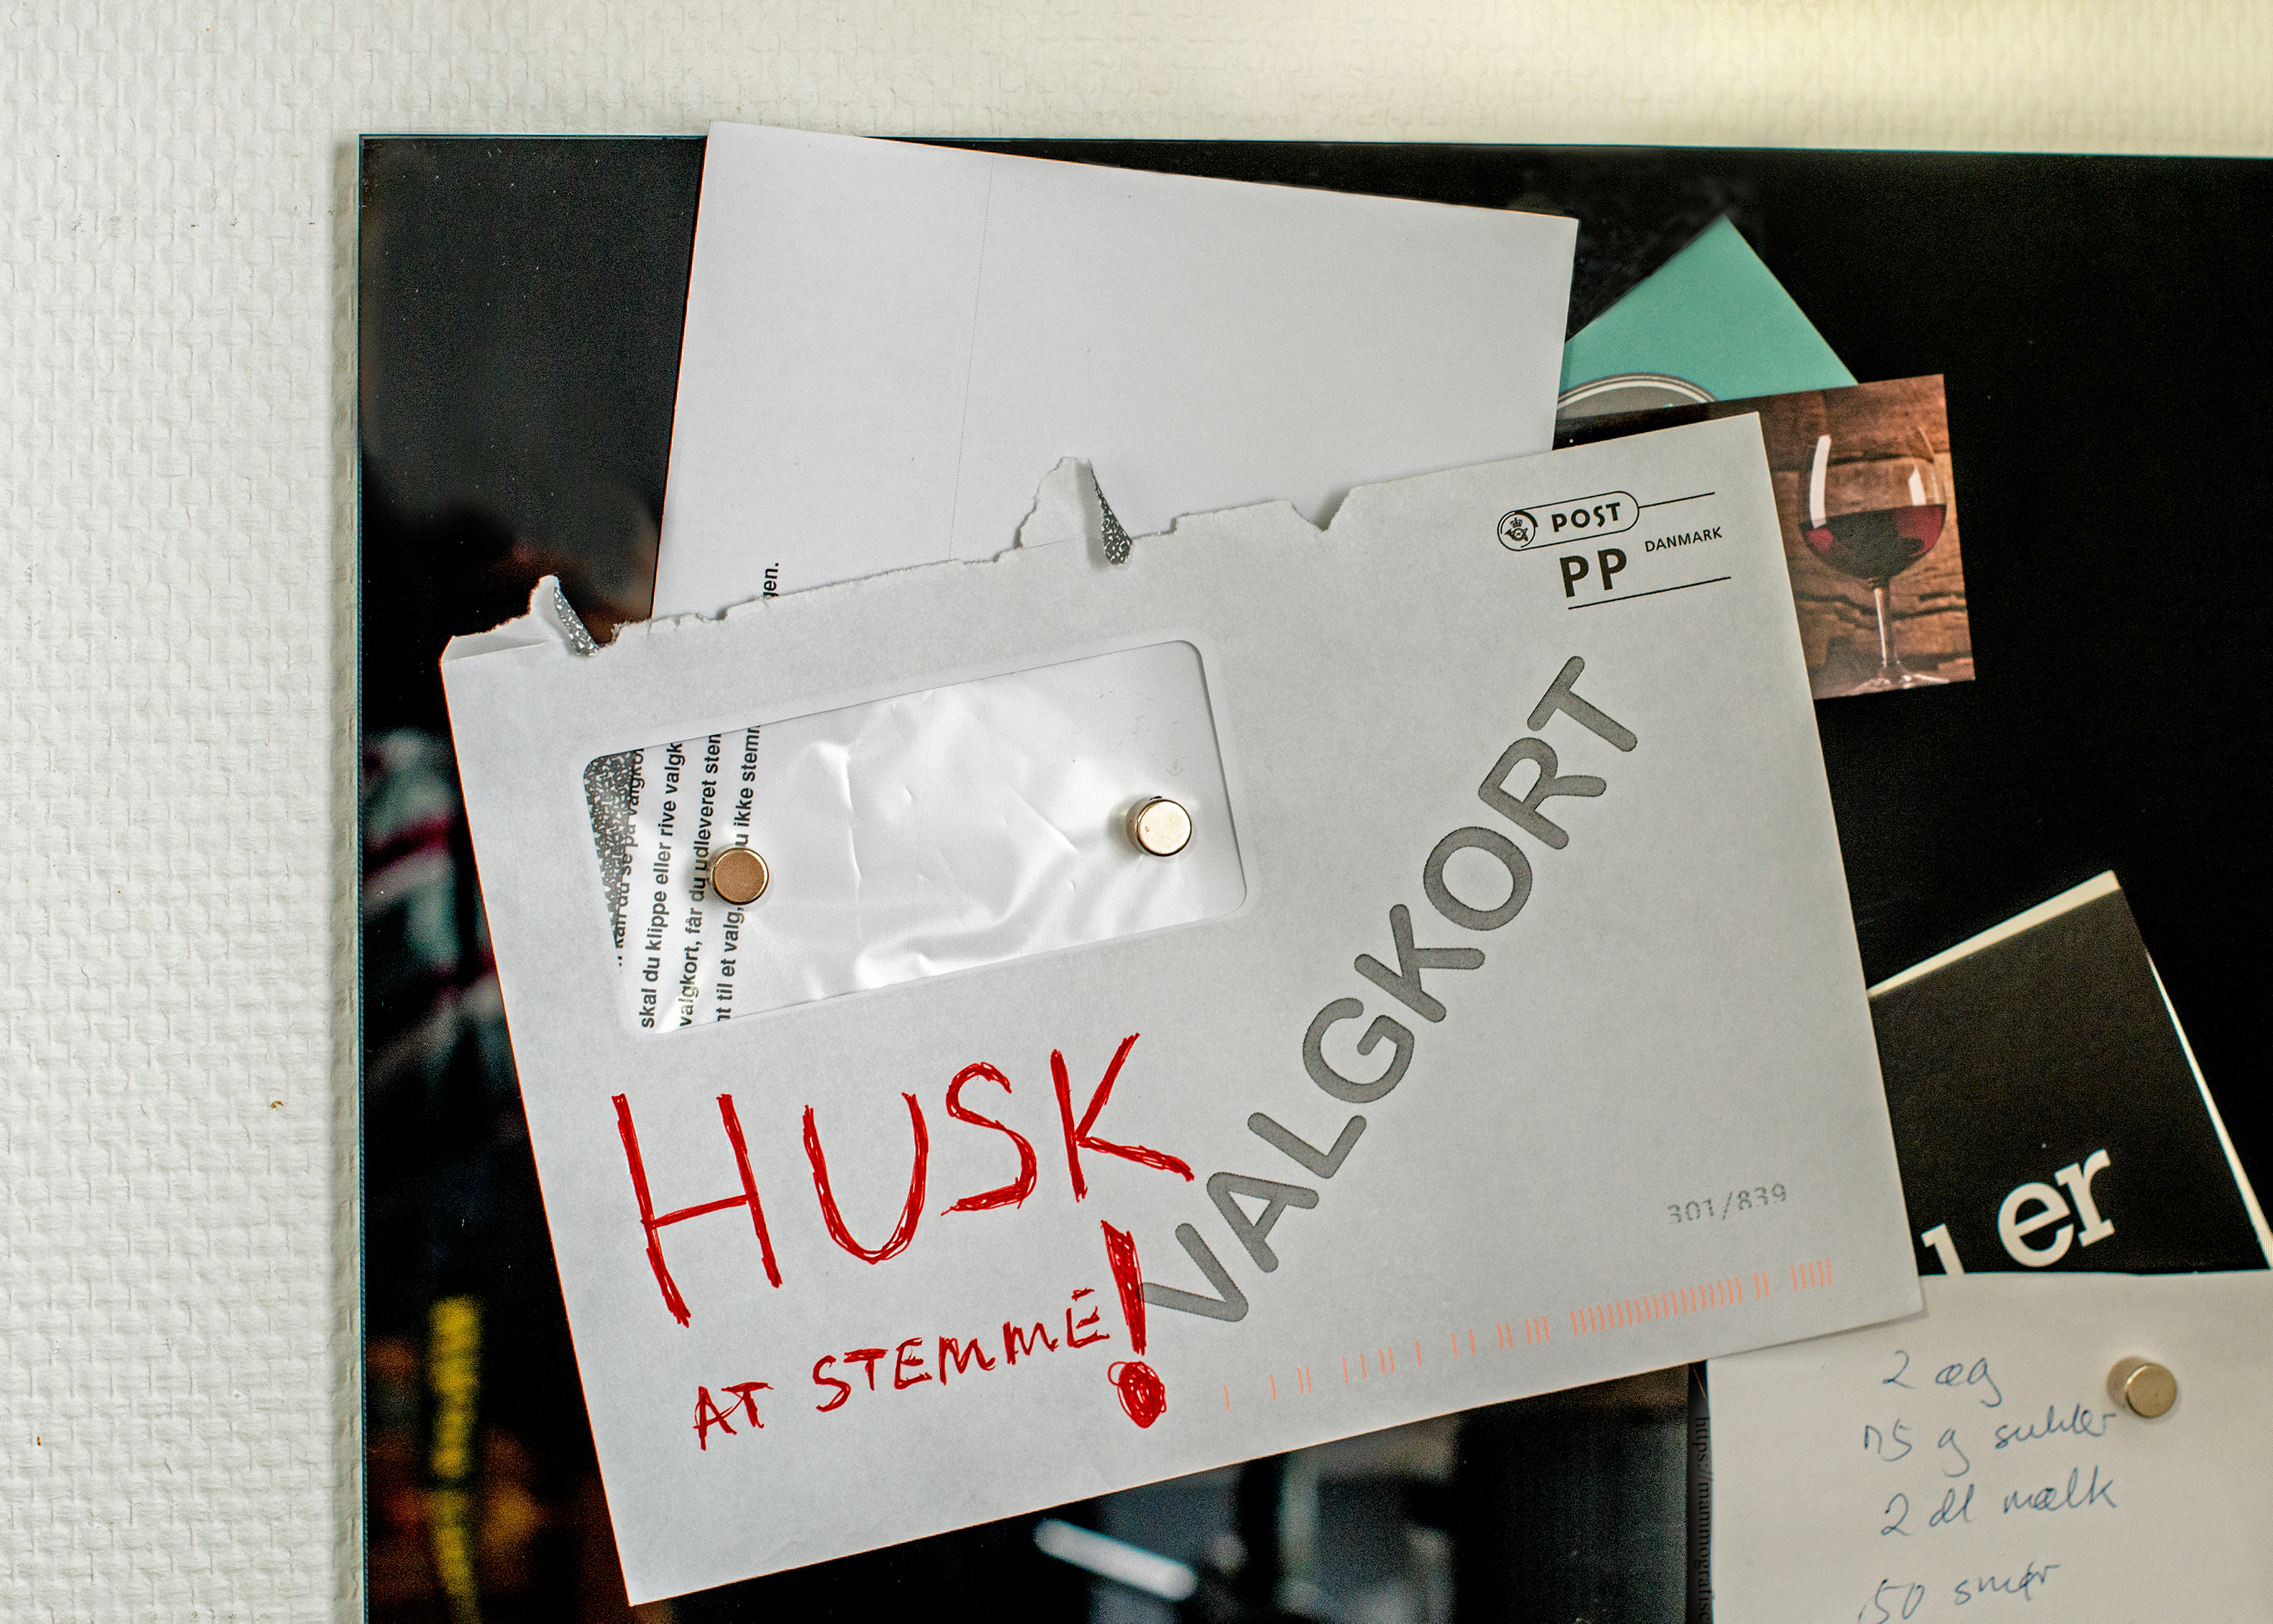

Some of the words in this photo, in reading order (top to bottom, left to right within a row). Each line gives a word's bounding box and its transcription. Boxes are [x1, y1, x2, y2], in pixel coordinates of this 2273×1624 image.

[1551, 502, 1621, 532] POST
[1559, 548, 1627, 598] PP
[1645, 526, 1723, 552] DANMARK
[664, 742, 686, 795] valgk
[658, 800, 677, 836] rive
[693, 779, 717, 871] udleveret
[733, 787, 754, 827] ikke
[735, 833, 749, 847] u
[652, 842, 672, 885] eller
[689, 877, 706, 902] du
[645, 890, 670, 951] klippe
[685, 907, 703, 934] får
[723, 907, 745, 952] valg,
[643, 957, 661, 982] du
[677, 941, 703, 1026] valgkort,
[721, 958, 736, 977] et
[639, 988, 657, 1029] skal
[716, 983, 733, 1001] til
[1137, 656, 1637, 1323] VALGKORT
[611, 1033, 1195, 1327] HUSK
[1668, 1183, 1787, 1225] 301/839
[1997, 1148, 2115, 1268] er
[1882, 1350, 1915, 1389] 2
[693, 1381, 774, 1451] AT
[1937, 1429, 1970, 1477] g
[1881, 1493, 1912, 1536] 2
[1929, 1483, 1974, 1527] dl
[2004, 1465, 2117, 1513] mælk
